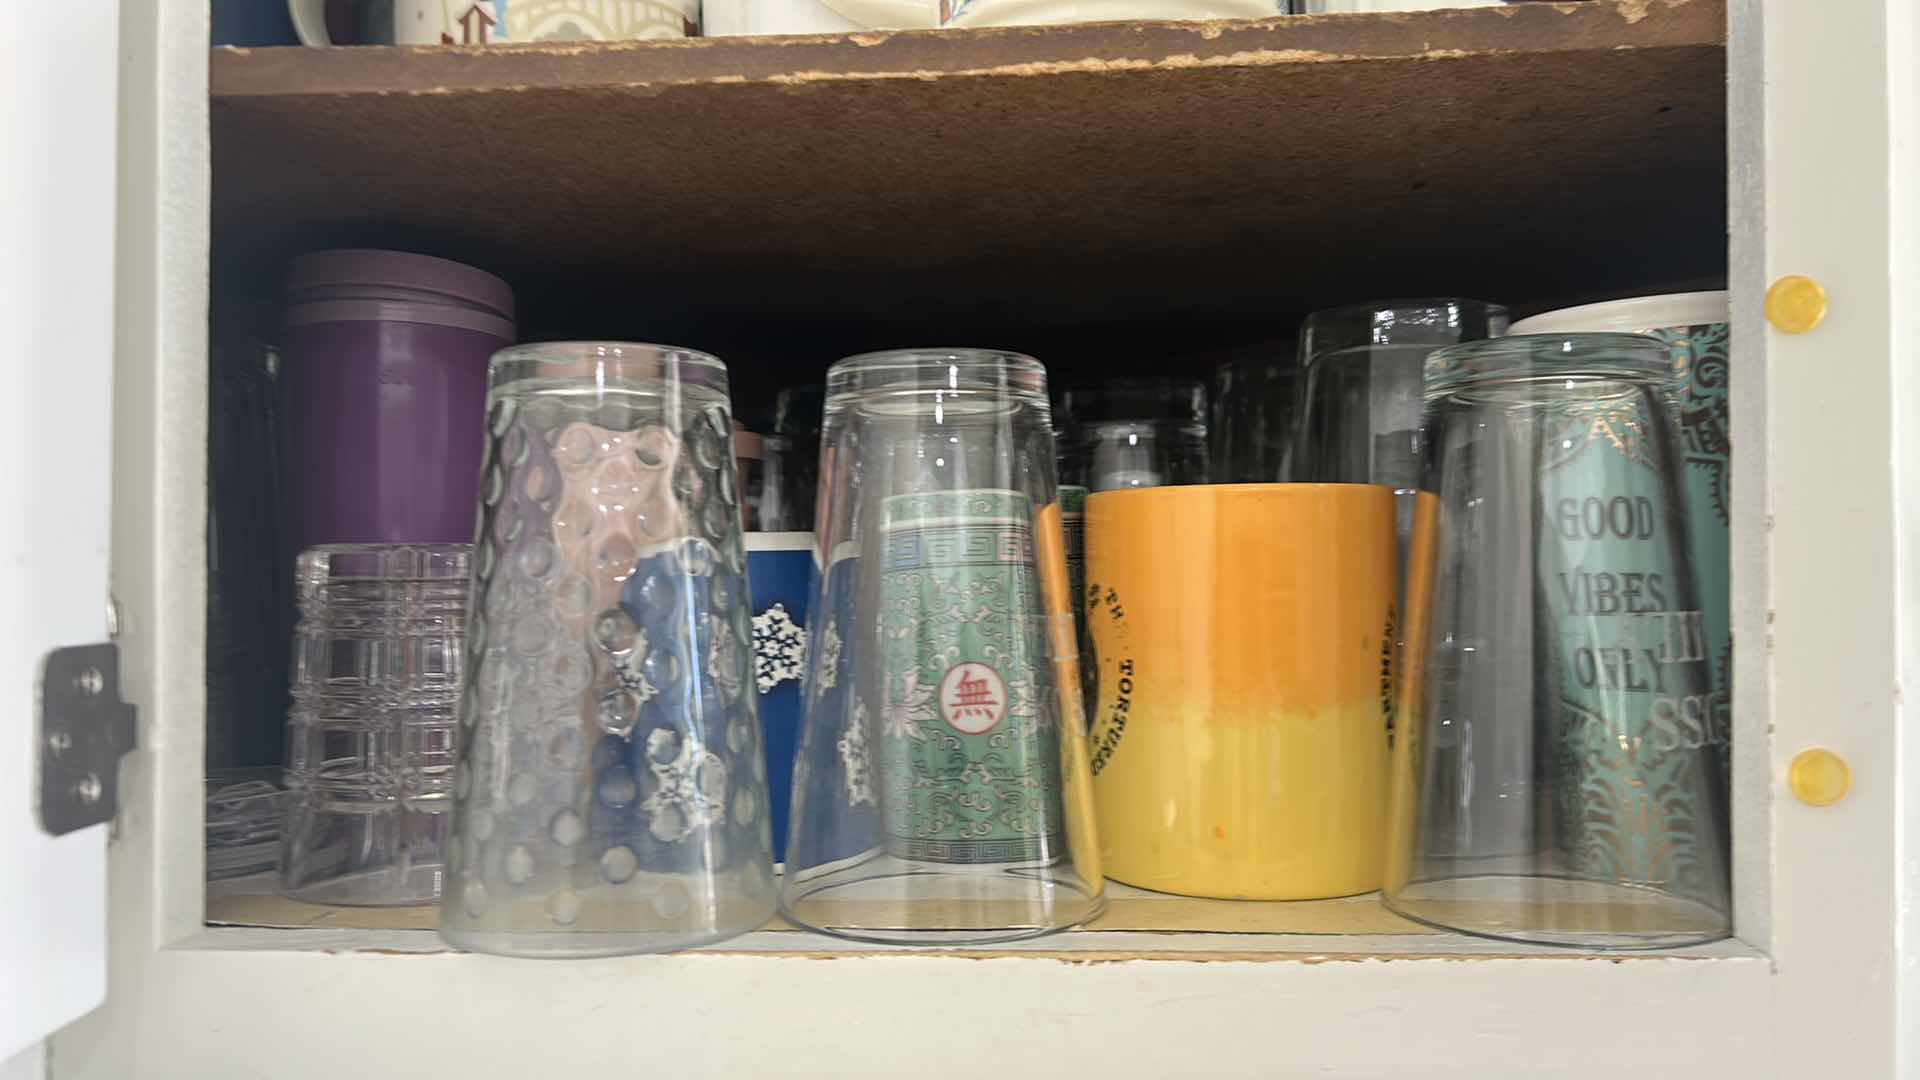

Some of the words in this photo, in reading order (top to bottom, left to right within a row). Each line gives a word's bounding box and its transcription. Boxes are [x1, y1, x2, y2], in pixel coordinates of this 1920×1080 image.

[1557, 496, 1655, 541] GOOD
[1555, 571, 1667, 618] VIBES
[1574, 647, 1666, 693] ONLY
[948, 669, 1001, 721] 無
